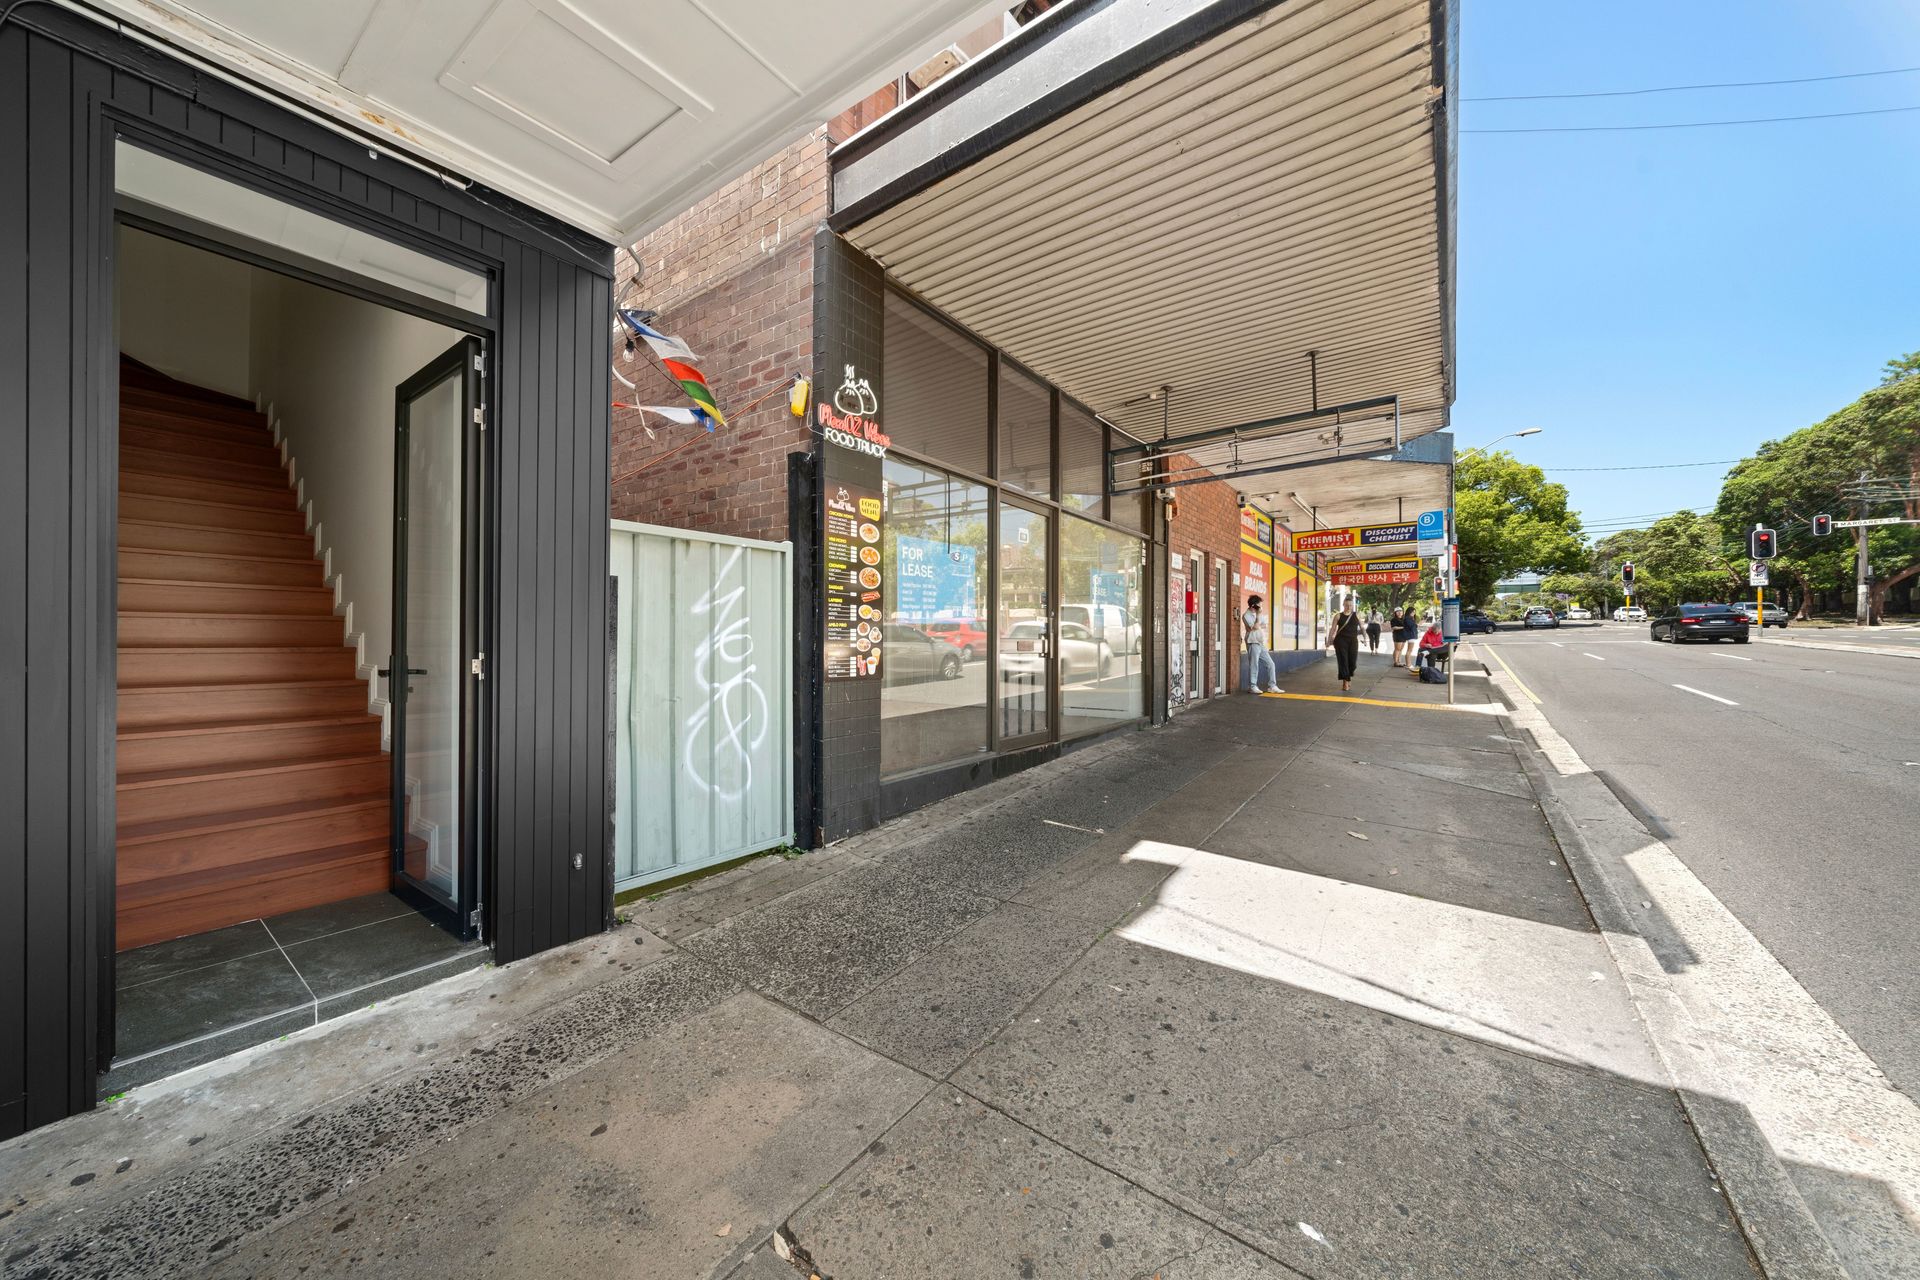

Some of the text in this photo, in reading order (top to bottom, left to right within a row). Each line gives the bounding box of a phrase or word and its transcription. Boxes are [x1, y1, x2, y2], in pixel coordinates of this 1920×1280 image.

[825, 428, 855, 447] FOOD
[854, 437, 886, 458] TRUCK
[861, 500, 879, 509] FOOD
[861, 507, 879, 516] MENU
[1423, 516, 1431, 524] B
[1840, 519, 1882, 527] MARGARET
[1365, 526, 1415, 536] DISCOUNT
[1300, 533, 1411, 545] CHEMIST CHEMIST
[902, 546, 923, 560] FOR
[902, 562, 933, 578] LEASE
[1249, 561, 1263, 578] REAL
[1368, 562, 1394, 571] DISCOUNT
[1394, 561, 1416, 569] CHEMIST
[1339, 572, 1411, 584] 한국인 약사 근무
[1244, 576, 1267, 594] BRANDS
